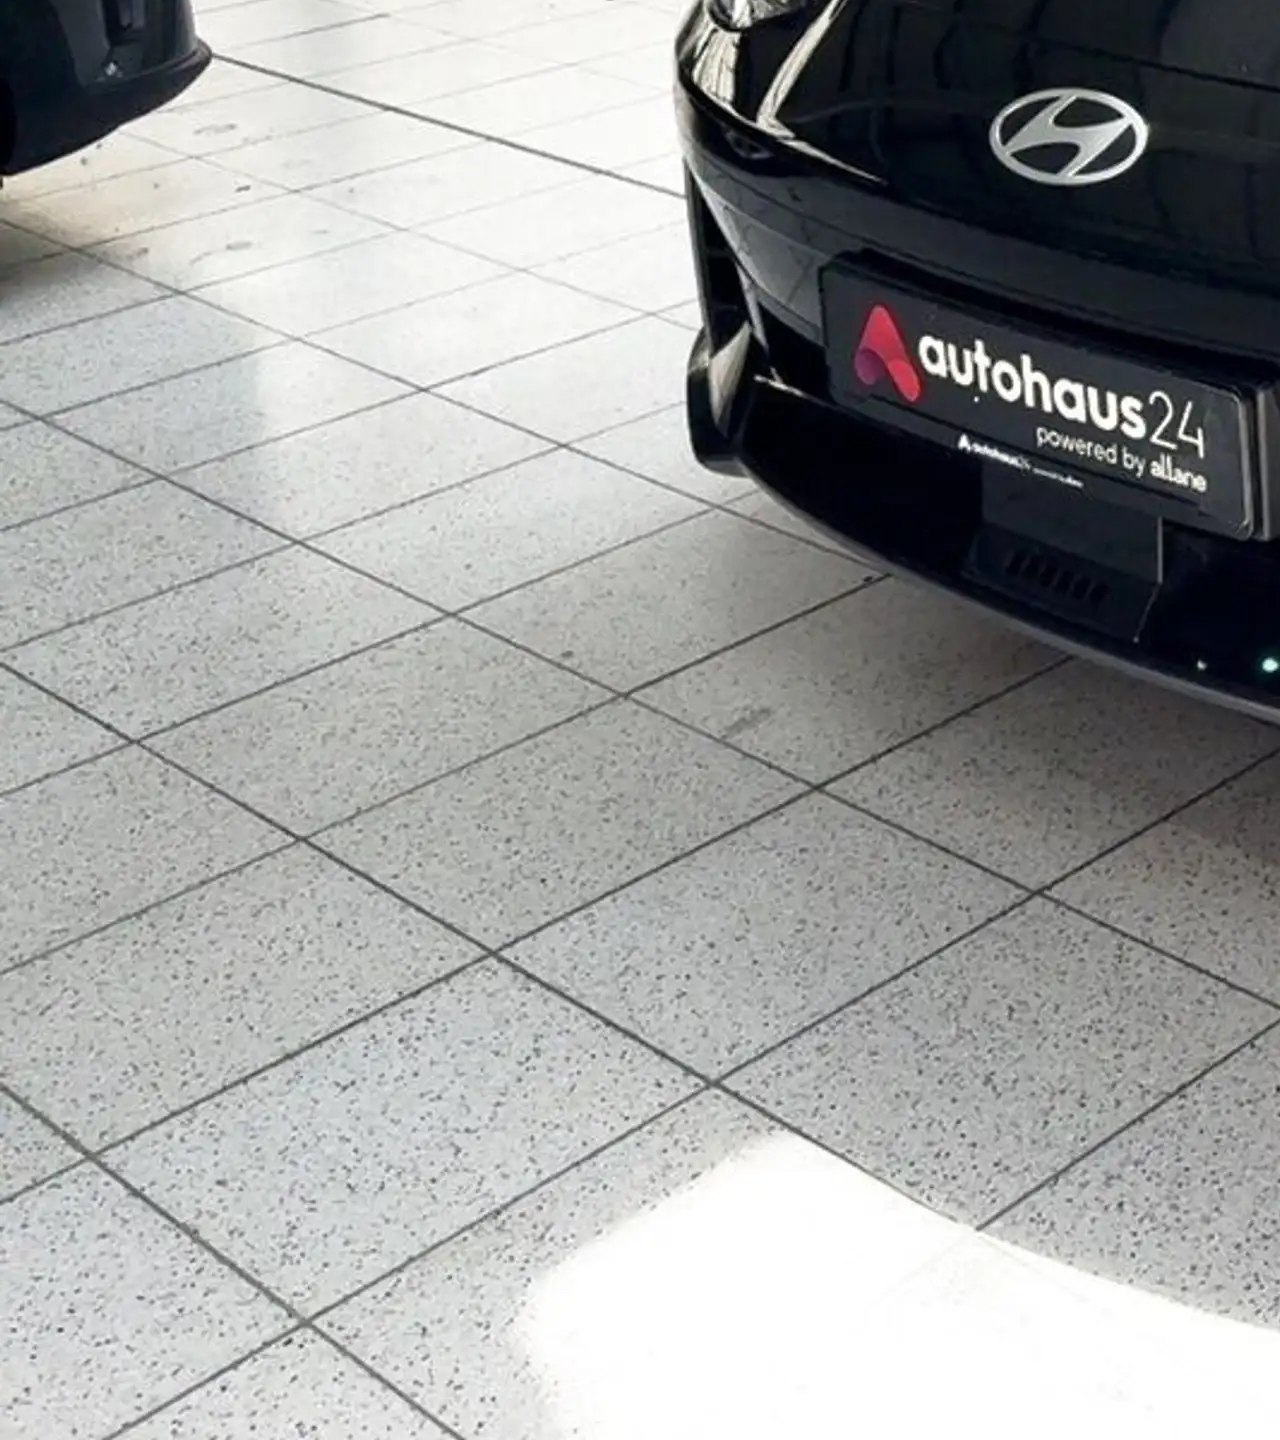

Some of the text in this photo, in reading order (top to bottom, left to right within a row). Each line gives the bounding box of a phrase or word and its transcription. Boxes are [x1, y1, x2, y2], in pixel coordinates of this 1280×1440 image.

[919, 334, 1205, 458] autohaus24
[1036, 426, 1116, 465] powered
[1122, 444, 1146, 478] by
[1150, 455, 1207, 493] allane
